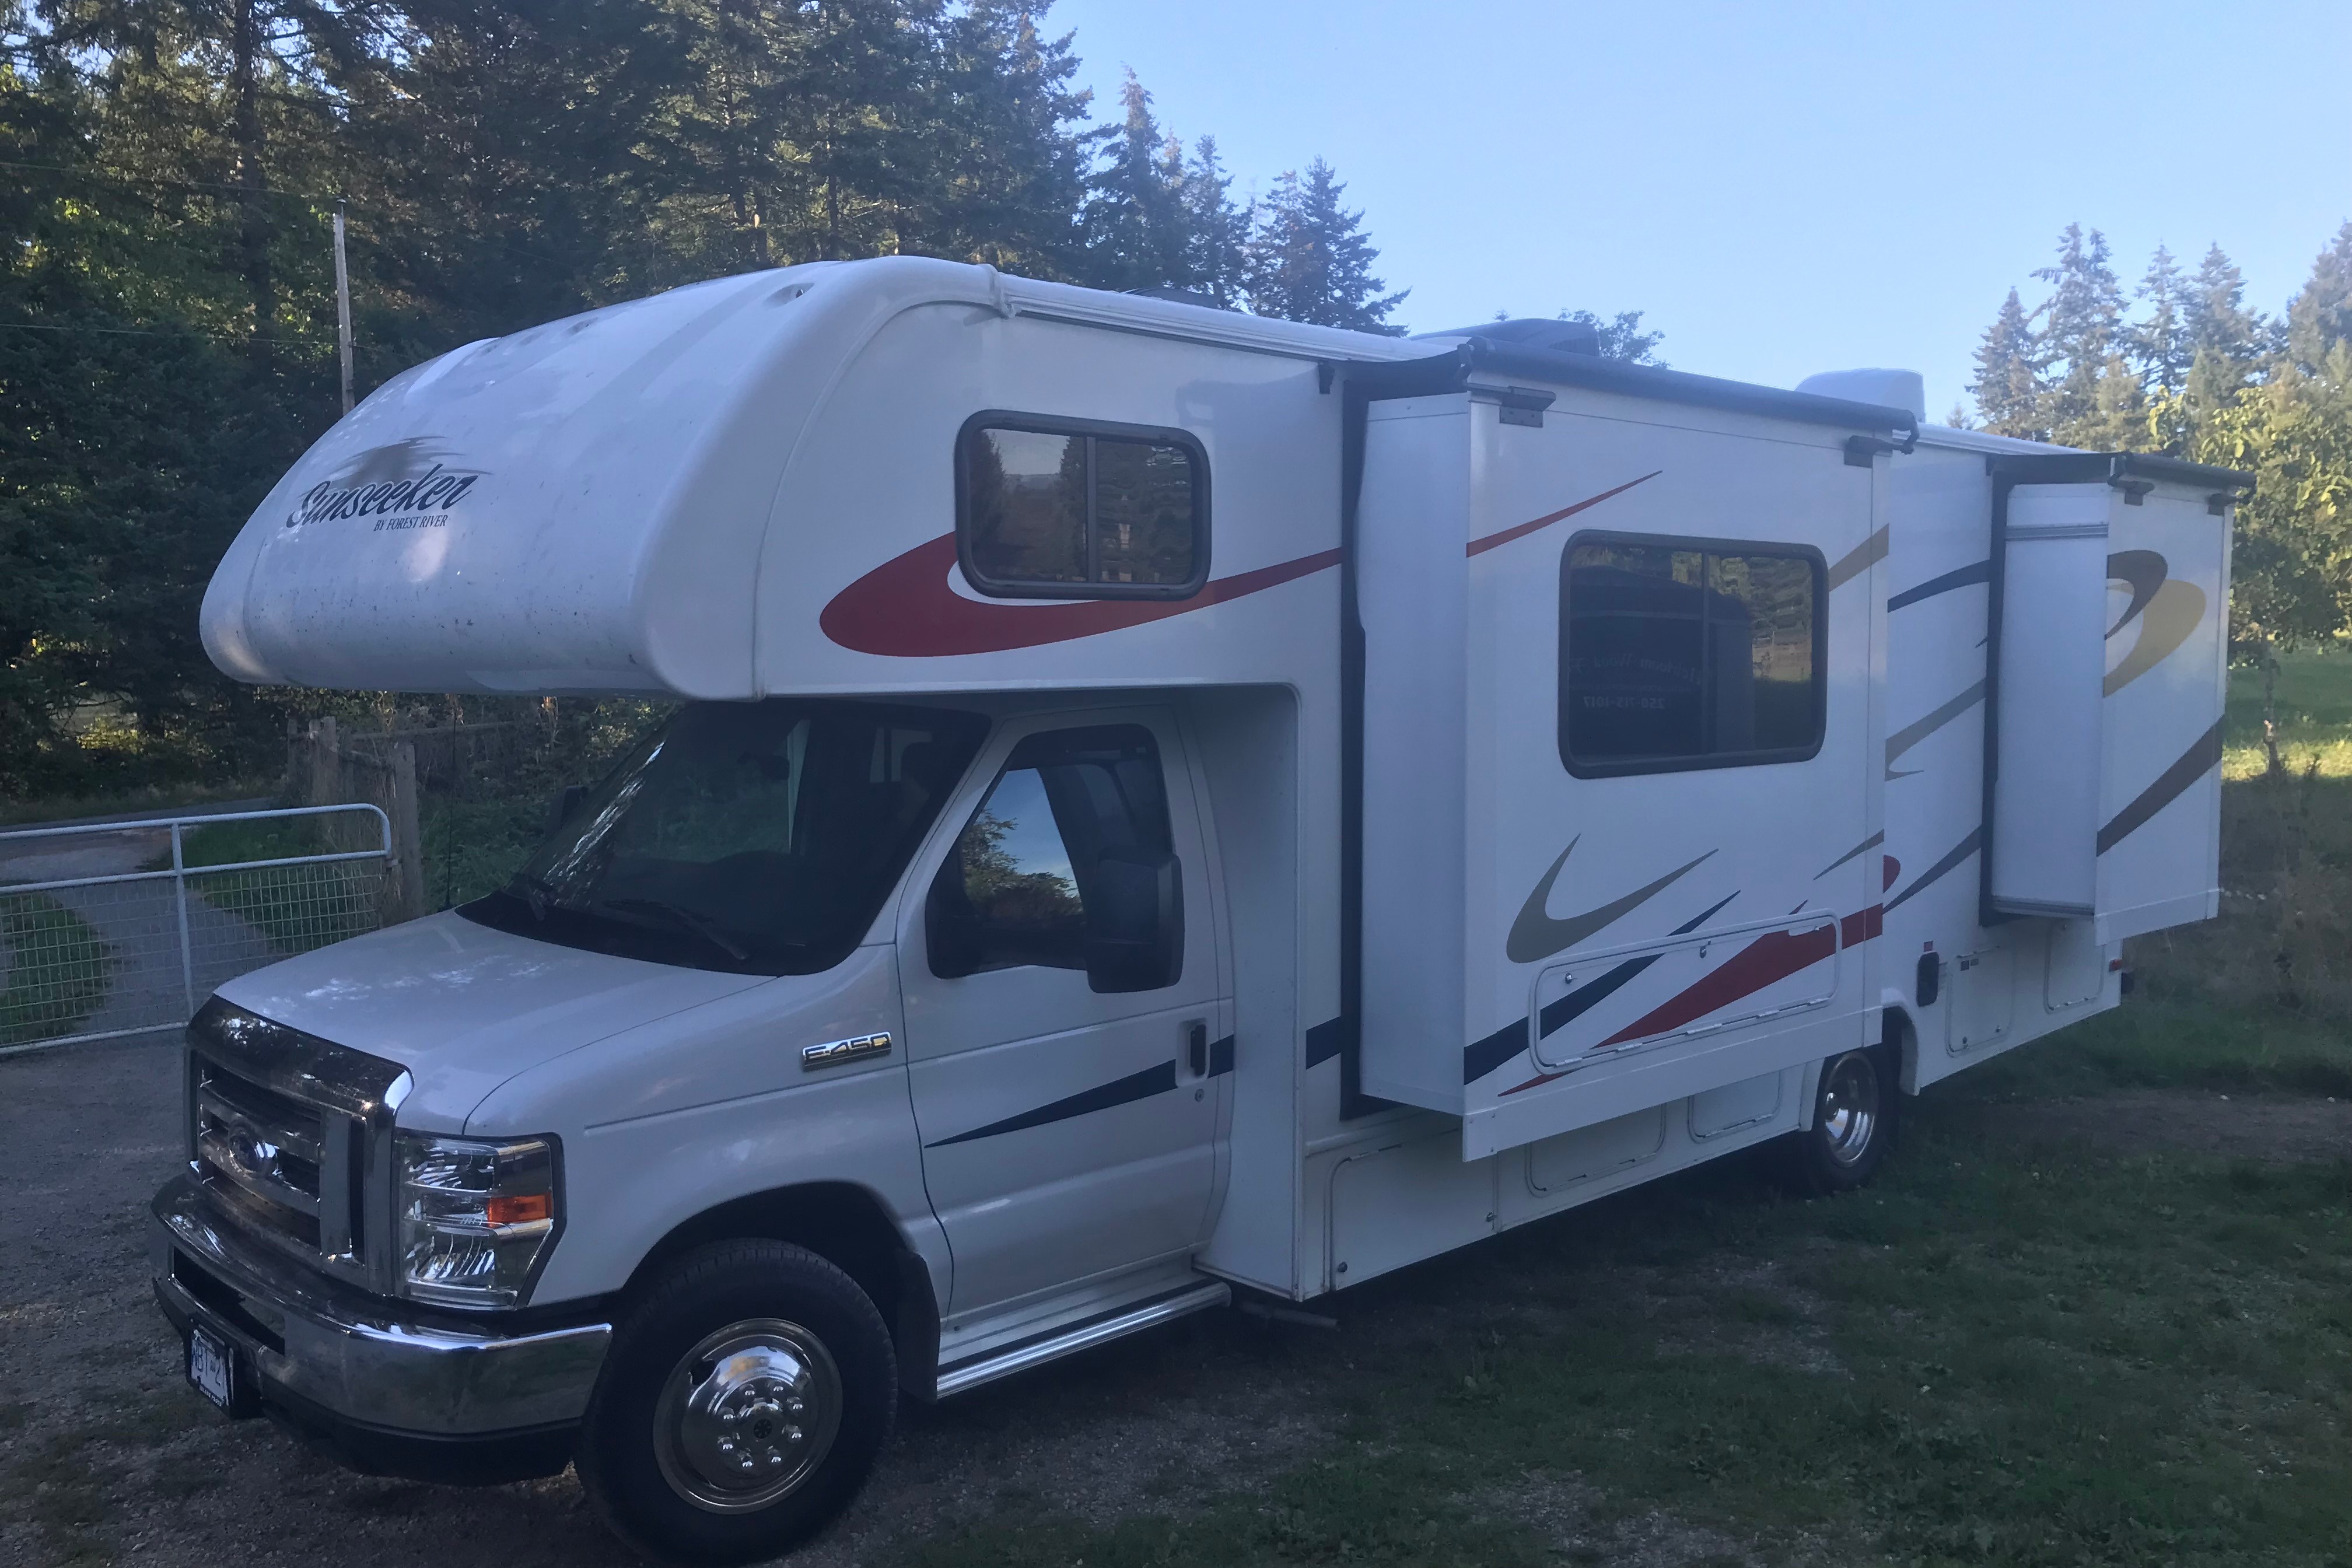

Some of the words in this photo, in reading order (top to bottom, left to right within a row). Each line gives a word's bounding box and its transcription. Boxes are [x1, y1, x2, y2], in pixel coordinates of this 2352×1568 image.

[286, 463, 480, 528] Sunseeker
[373, 519, 386, 531] BY
[386, 516, 419, 530] FOREST
[419, 514, 448, 528] RIVER
